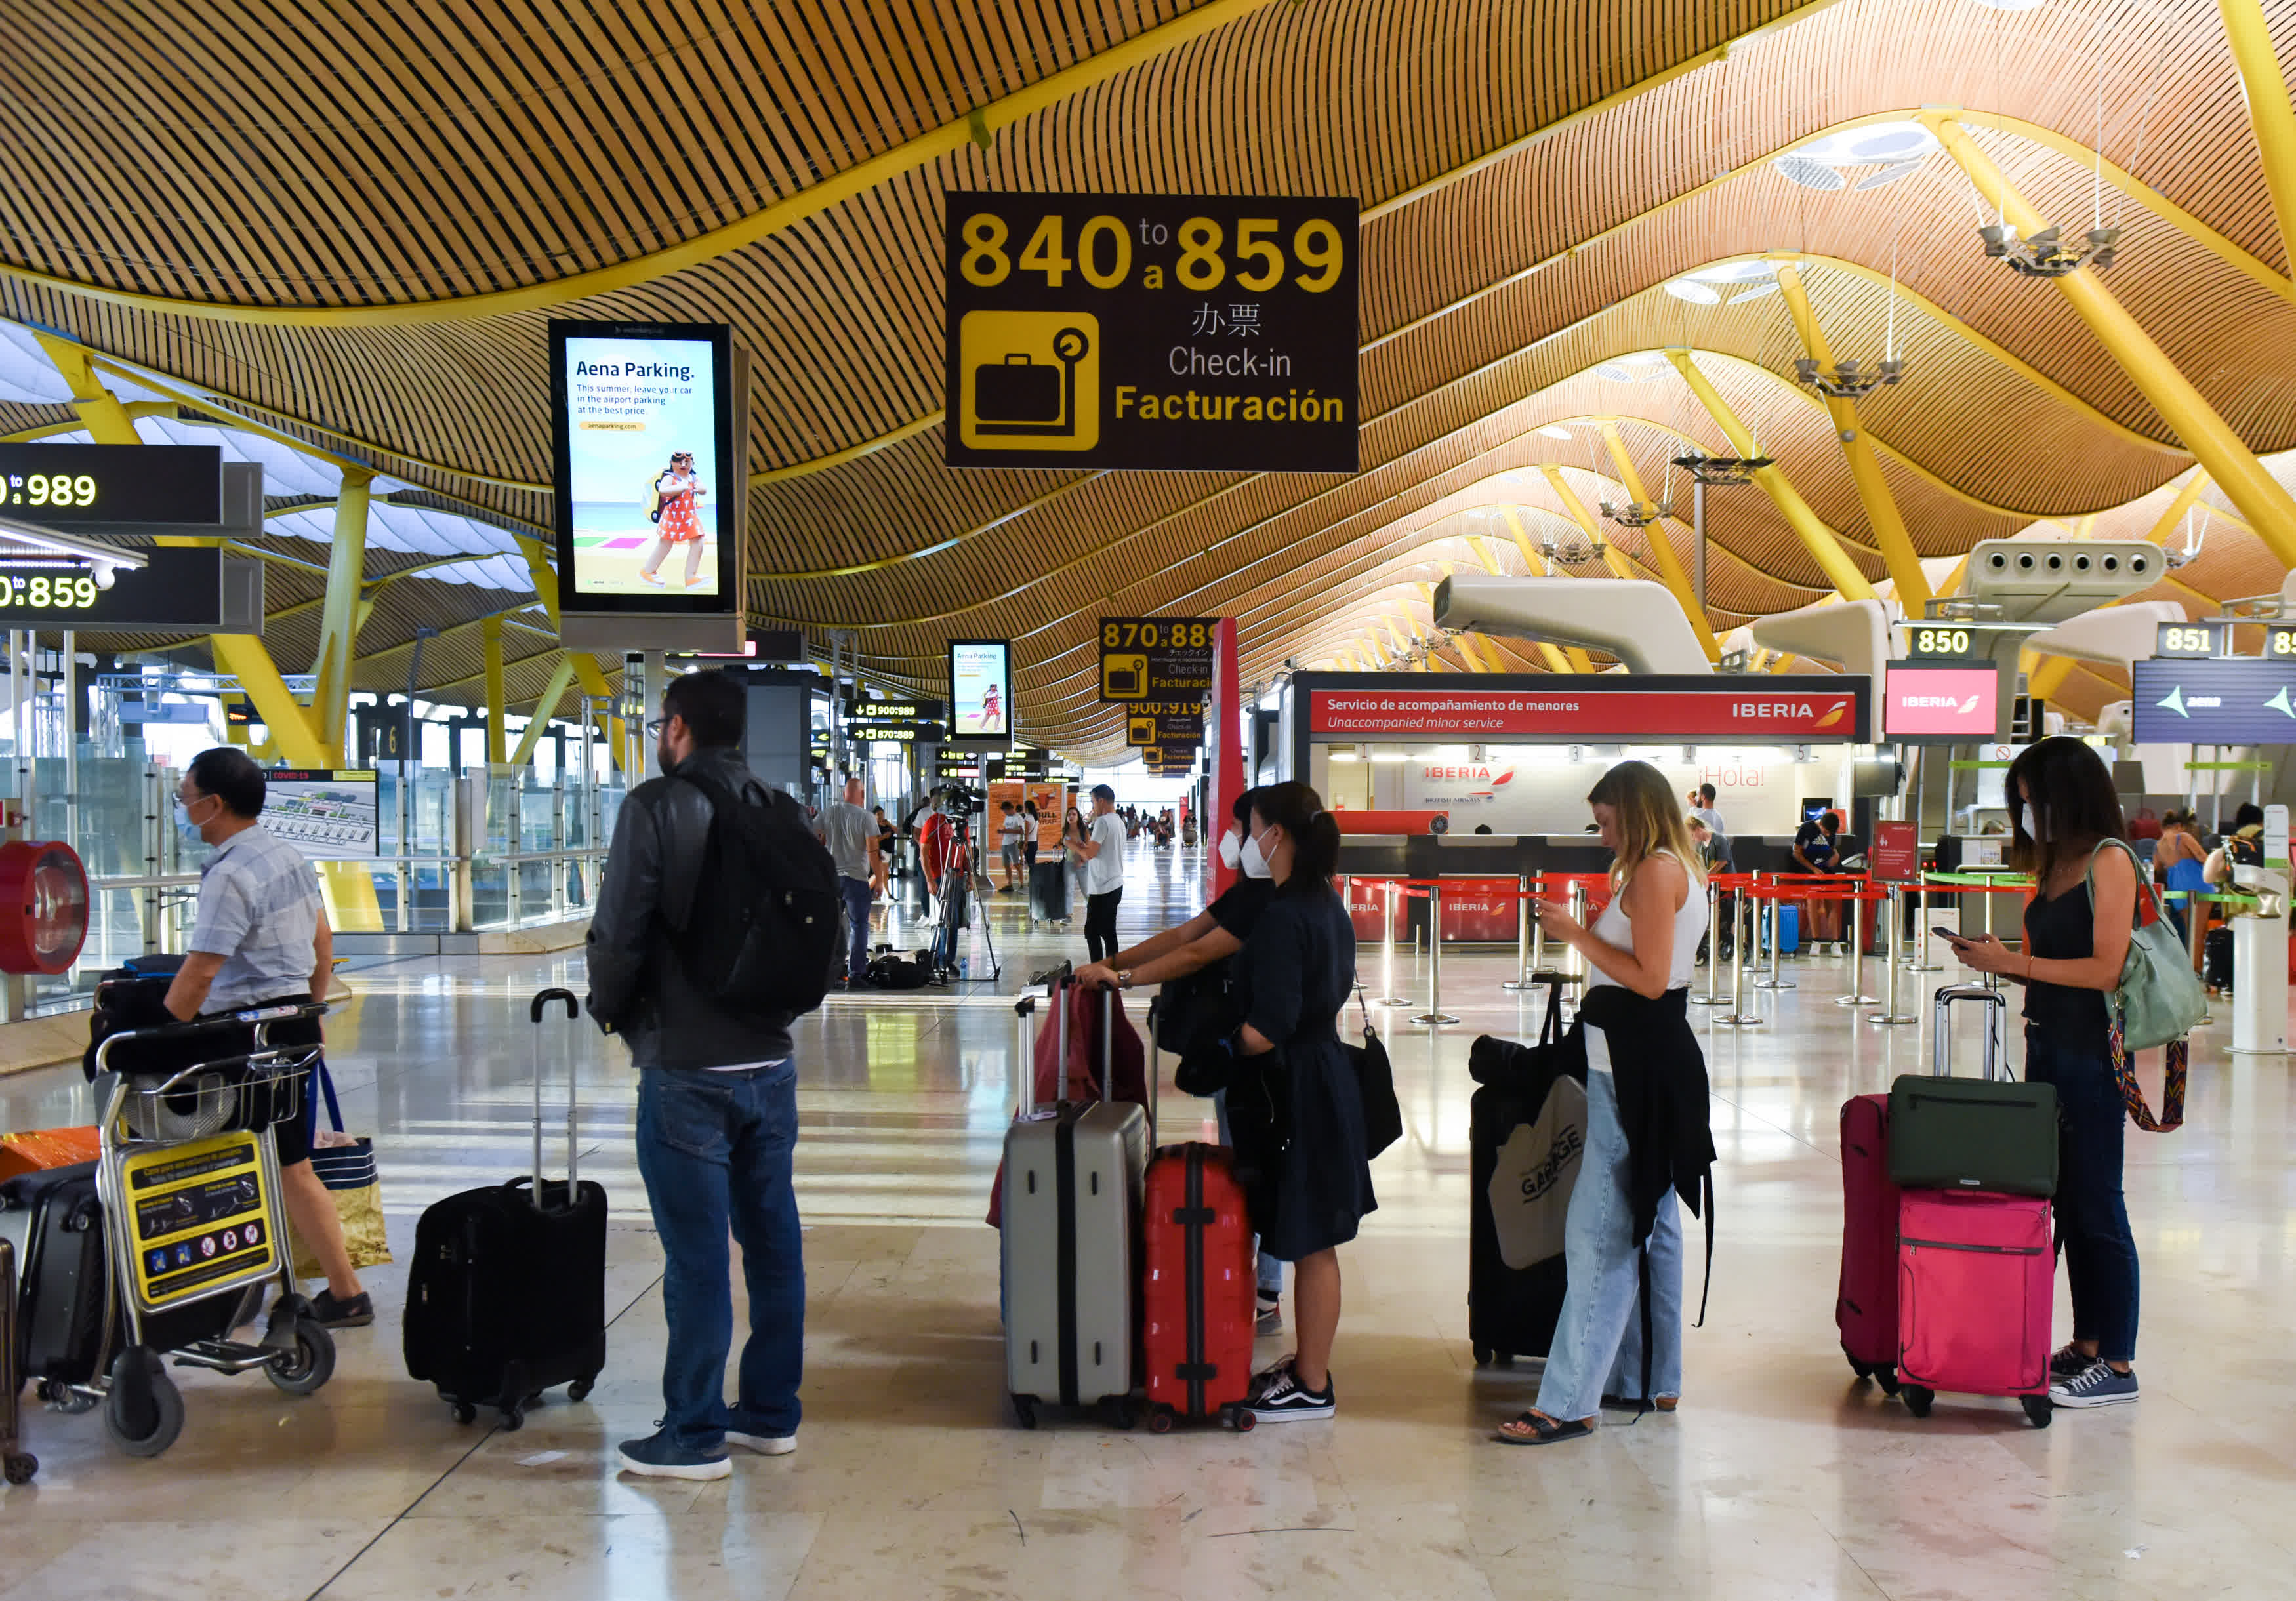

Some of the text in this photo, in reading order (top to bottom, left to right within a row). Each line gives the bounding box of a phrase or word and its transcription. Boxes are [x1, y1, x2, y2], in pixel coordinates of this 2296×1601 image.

[960, 213, 1343, 293] 840 to 859
[1143, 264, 1164, 289] a
[1191, 302, 1261, 337] 办票
[1168, 346, 1292, 377] Check-in
[577, 361, 695, 382] Aena Parking.
[634, 385, 656, 394] leave
[1116, 385, 1343, 422] Facturación
[10, 474, 23, 487] to
[27, 474, 96, 506] 989
[12, 491, 22, 504] a
[12, 575, 26, 589] to
[28, 577, 96, 609] 859
[15, 593, 24, 606] a
[1103, 624, 1158, 647] 870
[1160, 624, 1170, 634] to
[1160, 638, 1168, 647] a
[1918, 630, 1969, 653] 850
[2166, 627, 2211, 652] 851
[1169, 664, 1208, 674] Check-in
[1152, 676, 1212, 688] Facturaci
[1328, 699, 1580, 714] Servicio de acompañamiento de menores
[1902, 697, 1958, 707] IBERIA
[878, 706, 915, 716] 900 989
[1732, 703, 1814, 718] IBERIA
[1328, 717, 1504, 730] Unaccompanied minor service
[1158, 731, 1201, 739] Facturación
[1474, 744, 1481, 761] 2
[1574, 745, 1580, 761] 3
[1798, 744, 1805, 761] 5
[1425, 767, 1490, 778] IBERIA
[1350, 903, 1379, 912] ERIA
[1449, 903, 1490, 912] IBERIA
